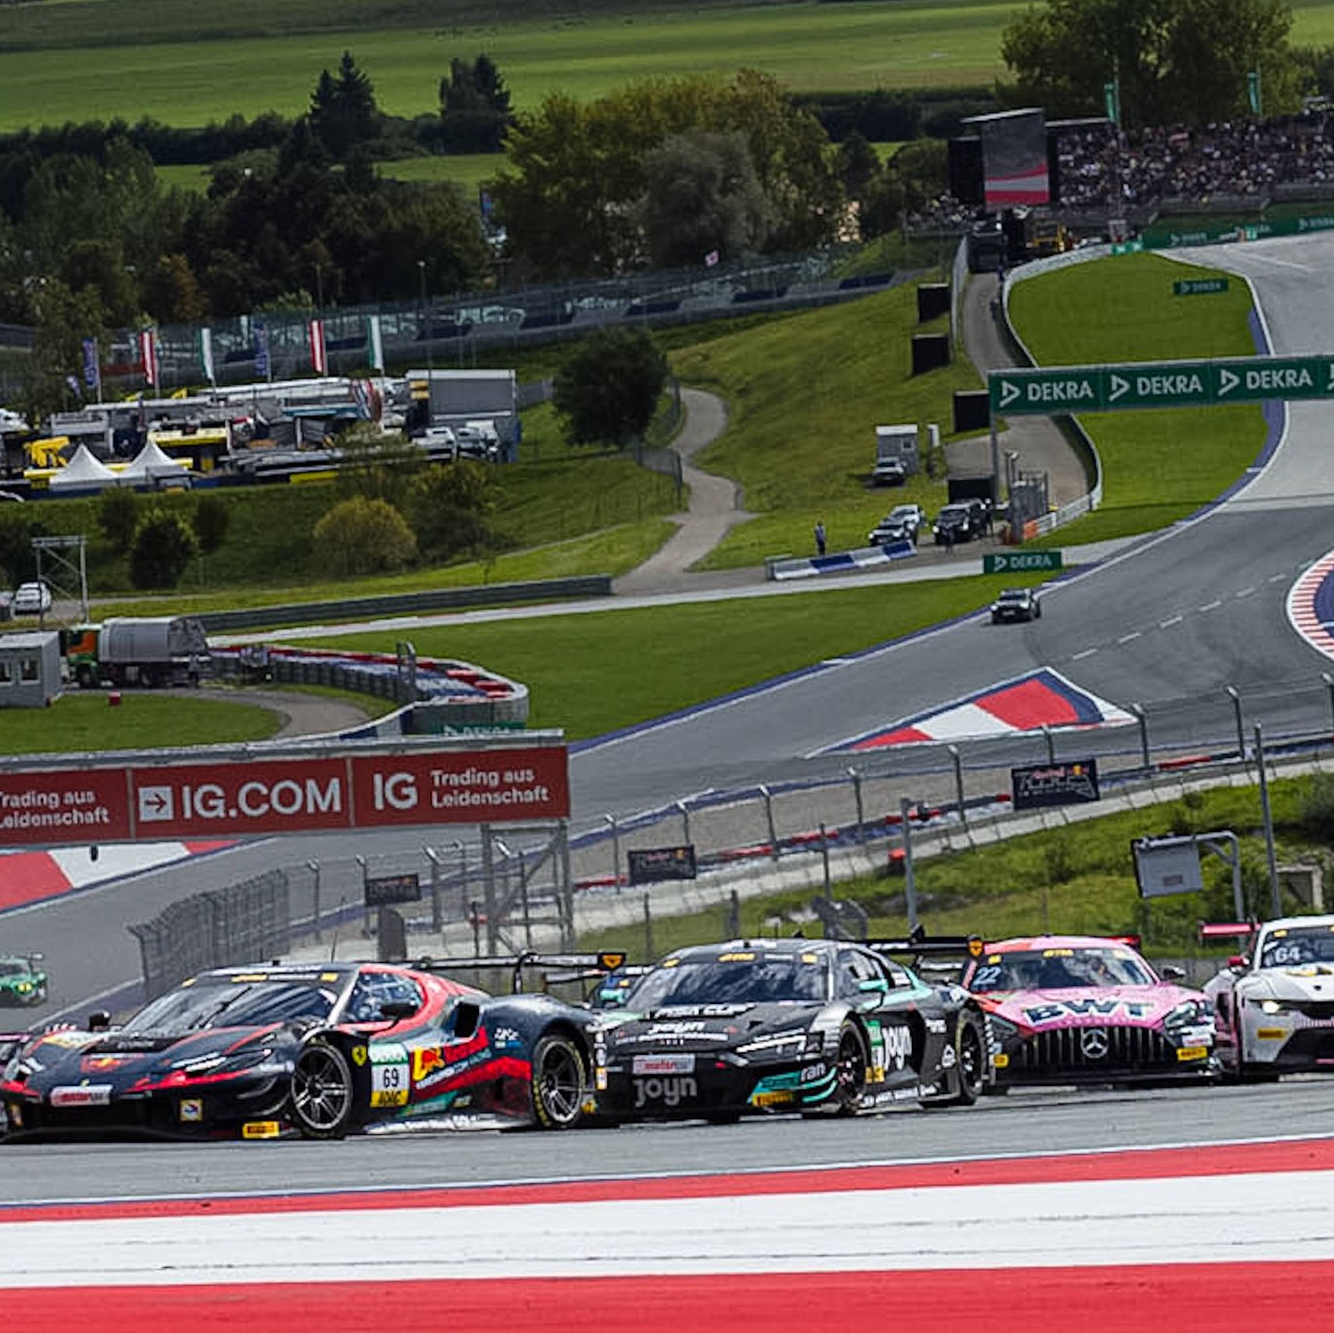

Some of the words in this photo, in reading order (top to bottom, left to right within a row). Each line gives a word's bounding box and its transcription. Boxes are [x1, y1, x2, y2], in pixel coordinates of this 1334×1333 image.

[1137, 375, 1203, 396] DEKRA
[1246, 369, 1313, 391] DEKRA
[1027, 381, 1094, 401] DEKRA
[430, 768, 499, 787] Trading
[504, 769, 535, 783] aus
[63, 790, 96, 804] aus
[182, 777, 342, 819] IG.COM
[373, 772, 418, 811] IG
[432, 786, 549, 809] Leidenschaft
[1274, 946, 1301, 963] 64
[973, 966, 1003, 985] 22
[1023, 998, 1155, 1026] BWT
[881, 1025, 913, 1073] joyn
[382, 1067, 399, 1088] 69
[800, 1062, 826, 1082] ran
[634, 1077, 698, 1108] joyn
